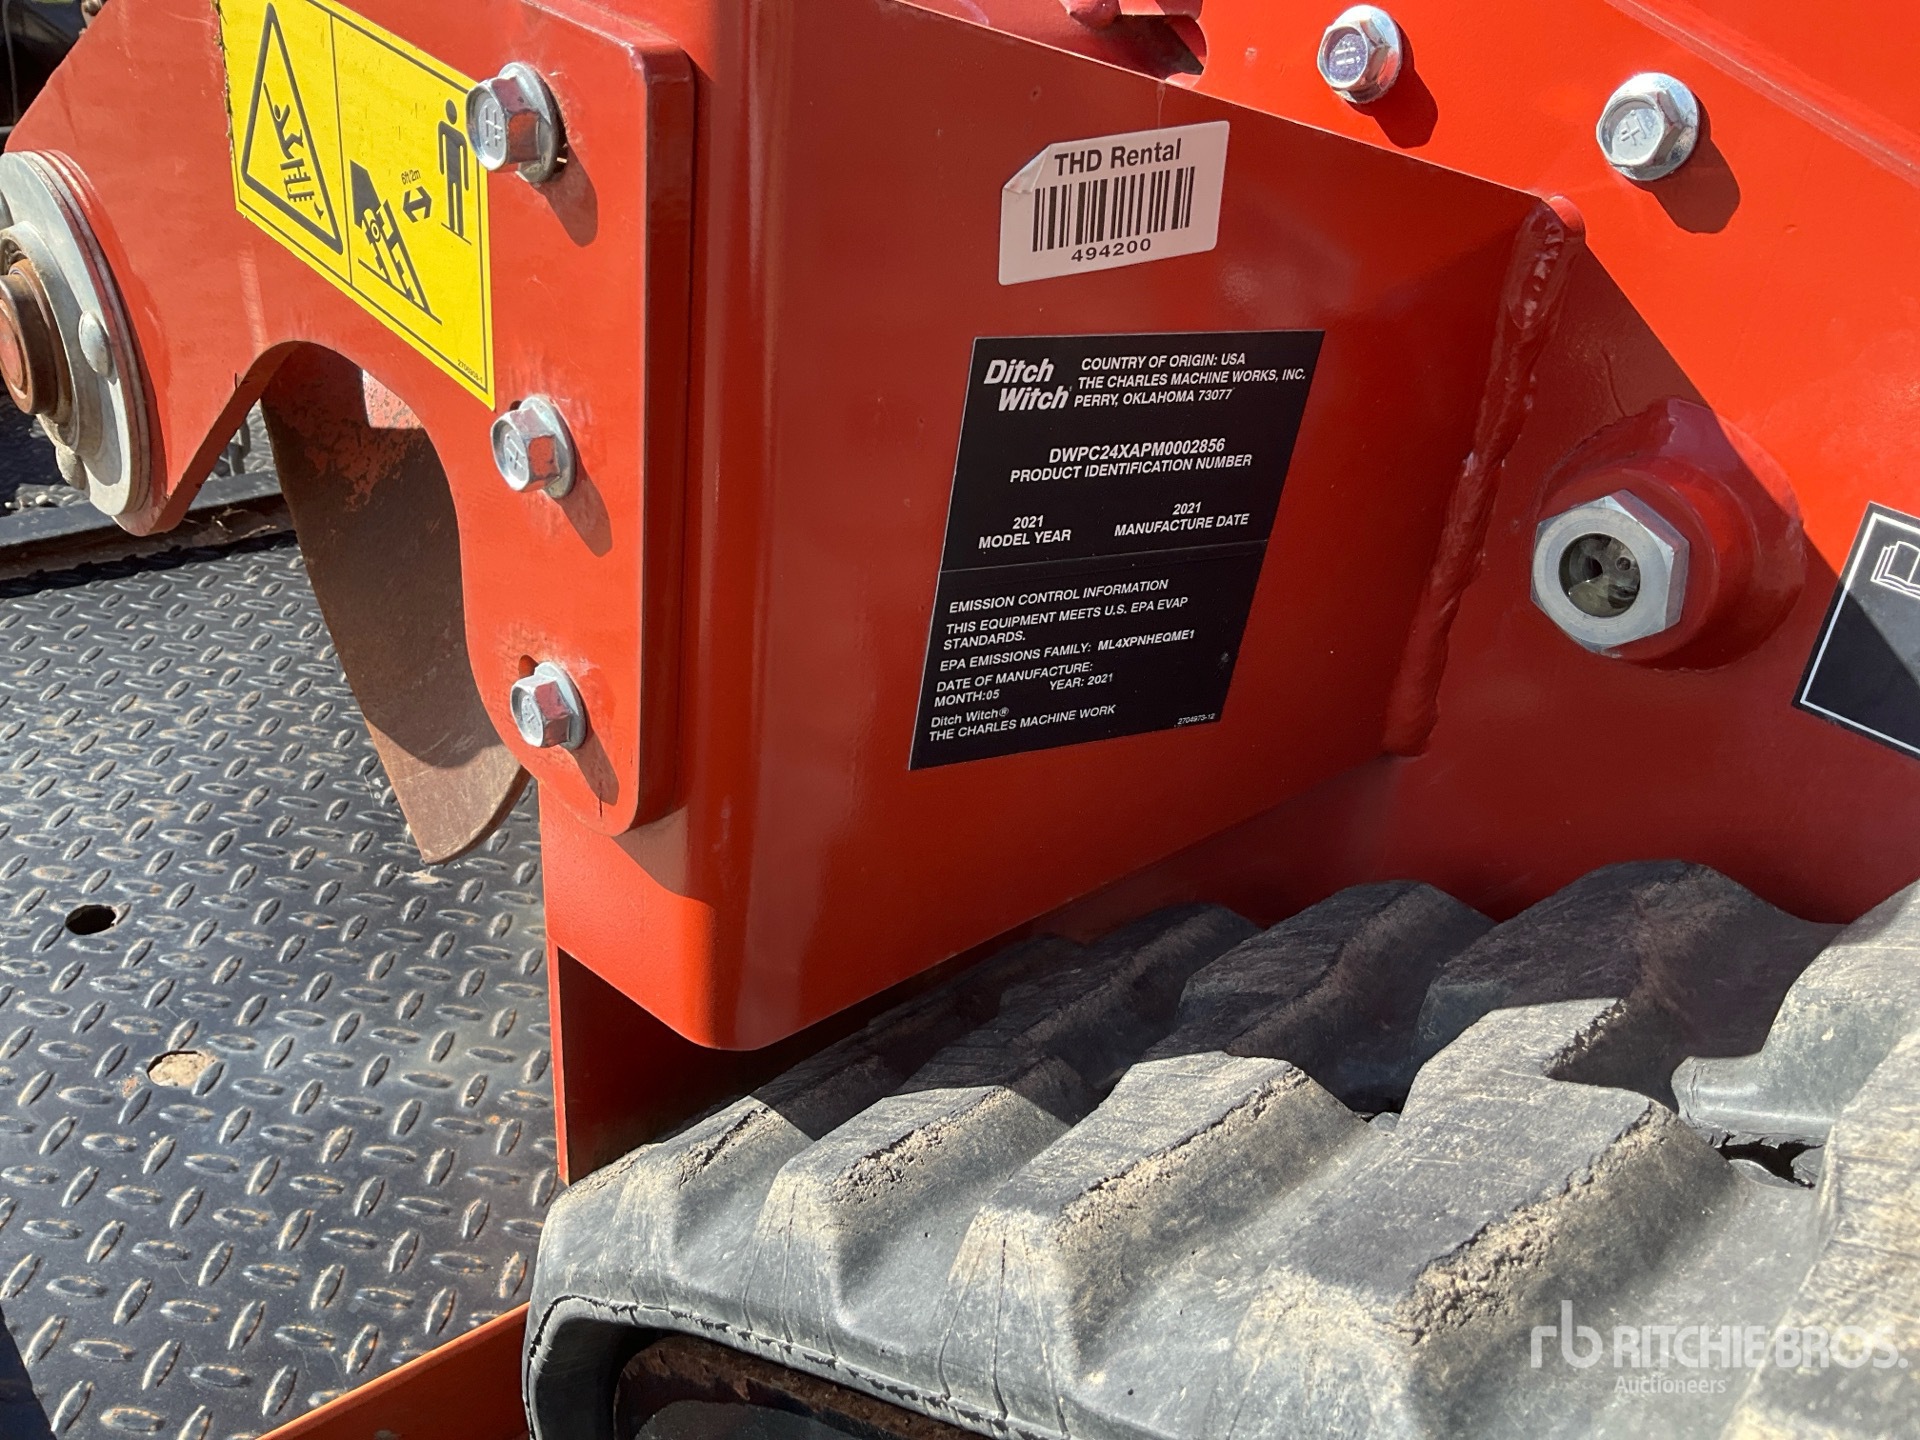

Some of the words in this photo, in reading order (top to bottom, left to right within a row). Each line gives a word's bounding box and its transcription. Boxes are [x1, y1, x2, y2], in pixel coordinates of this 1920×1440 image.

[1054, 149, 1102, 176] THD
[1110, 138, 1182, 169] Rental
[1071, 238, 1152, 262] 494200
[983, 358, 1055, 384] Ditch
[1081, 355, 1147, 370] COUNTRY
[1148, 355, 1167, 368] OF
[1169, 353, 1218, 367] ORIGIN:
[1221, 352, 1246, 365] USA
[1078, 376, 1104, 389] THE
[1107, 374, 1168, 388] CHARLES
[1170, 371, 1229, 385] MACHINE
[1232, 369, 1279, 383] WORKS,
[1282, 368, 1306, 381] INC.
[998, 385, 1069, 412] Witch
[1074, 393, 1119, 407] PERRY,
[1122, 390, 1194, 405] OKLAHOMA
[1198, 389, 1233, 401] 73077
[1049, 438, 1226, 464] DWPC24XAPM0002856
[1010, 466, 1082, 483] PRODUCT
[1085, 458, 1193, 478] IDENTIFICATION
[1195, 454, 1253, 471] NUMBER
[1172, 502, 1202, 516] 2021
[1012, 515, 1044, 530] 2021
[1114, 516, 1214, 537] MANUFACTURE
[1216, 513, 1250, 528] DATE
[978, 534, 1031, 550] MODEL
[1034, 529, 1072, 545] YEAR
[949, 596, 1015, 613] EMISSION
[1018, 589, 1080, 606] CONTROL
[1082, 579, 1169, 599] INFORMATION
[946, 621, 976, 635] THIS
[980, 611, 1057, 631] EQUIPMENT
[1058, 606, 1101, 622] MEETS
[1104, 604, 1128, 616] U.S.
[1130, 600, 1155, 613] EPA
[1157, 596, 1189, 610] EVAP
[940, 659, 966, 672] EPA
[969, 648, 1041, 668] EMISSIONS
[1044, 642, 1092, 659] FAMILY:
[1097, 629, 1195, 651] ML4XPNHEQME1
[943, 630, 1026, 651] STANDARDS.
[936, 678, 972, 693] DATE
[974, 674, 993, 687] OF
[995, 661, 1094, 685] MANUFACTURE:
[1050, 679, 1085, 691] YEAR:
[1087, 673, 1113, 686] 2021
[934, 689, 1000, 708] MONTH:05
[929, 730, 955, 742] THE
[957, 719, 1017, 738] CHARLES
[1019, 709, 1077, 728] MACHINE
[1079, 704, 1117, 719] WORK
[931, 714, 962, 728] Ditch
